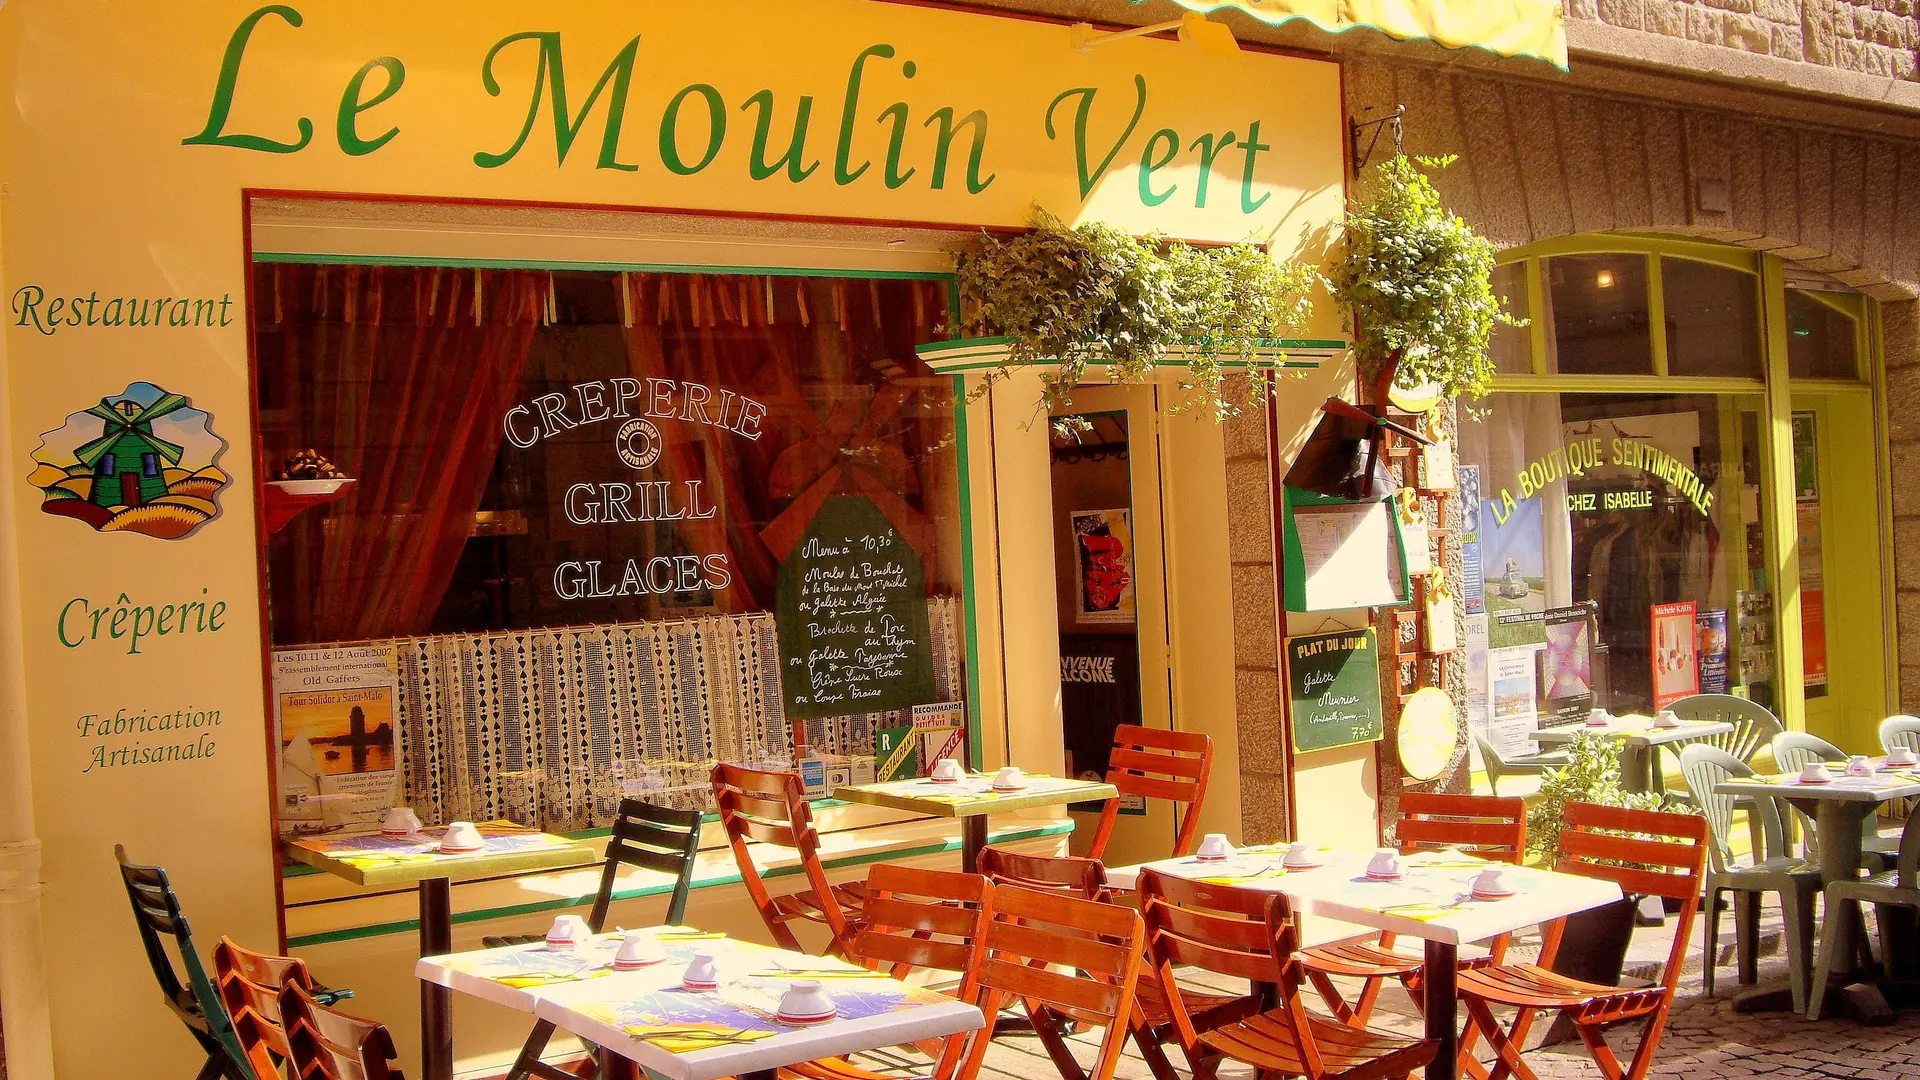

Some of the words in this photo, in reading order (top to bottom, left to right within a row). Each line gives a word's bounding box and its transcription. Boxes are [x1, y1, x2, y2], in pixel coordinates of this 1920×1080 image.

[181, 4, 406, 156] Le
[473, 31, 997, 195] Moulin
[1045, 73, 1272, 215] Vert
[12, 285, 233, 336] Restaurant
[503, 377, 767, 449] CREPERIE
[619, 421, 658, 441] FABRICATION
[620, 446, 659, 466] ARTISANALE
[1490, 488, 1518, 527] LA
[1518, 438, 1604, 500] BOUTIQUE
[1612, 438, 1715, 517] SENTIMENTALE
[564, 480, 717, 525] GRILL
[1567, 494, 1597, 512] CHEZ
[1604, 491, 1653, 510] ISABELLE
[802, 537, 839, 558] Menu
[554, 554, 731, 600] GLACES
[57, 587, 227, 655] Crêperie
[277, 654, 294, 663] Les
[334, 650, 344, 660] 12
[371, 647, 393, 658] 2007
[1297, 640, 1324, 659] PLAT
[1326, 638, 1339, 652] DU
[1341, 637, 1368, 650] JOUR
[303, 676, 321, 685] Old
[326, 674, 360, 684] Gaffers
[288, 695, 307, 707] Tour
[343, 690, 384, 703] Saint-Malo
[914, 702, 962, 714] RECOMMANDE
[76, 705, 222, 738] Fabrication
[82, 732, 216, 773] Artisanale
[881, 733, 891, 751] R
[878, 731, 915, 783] RESTAURANT
